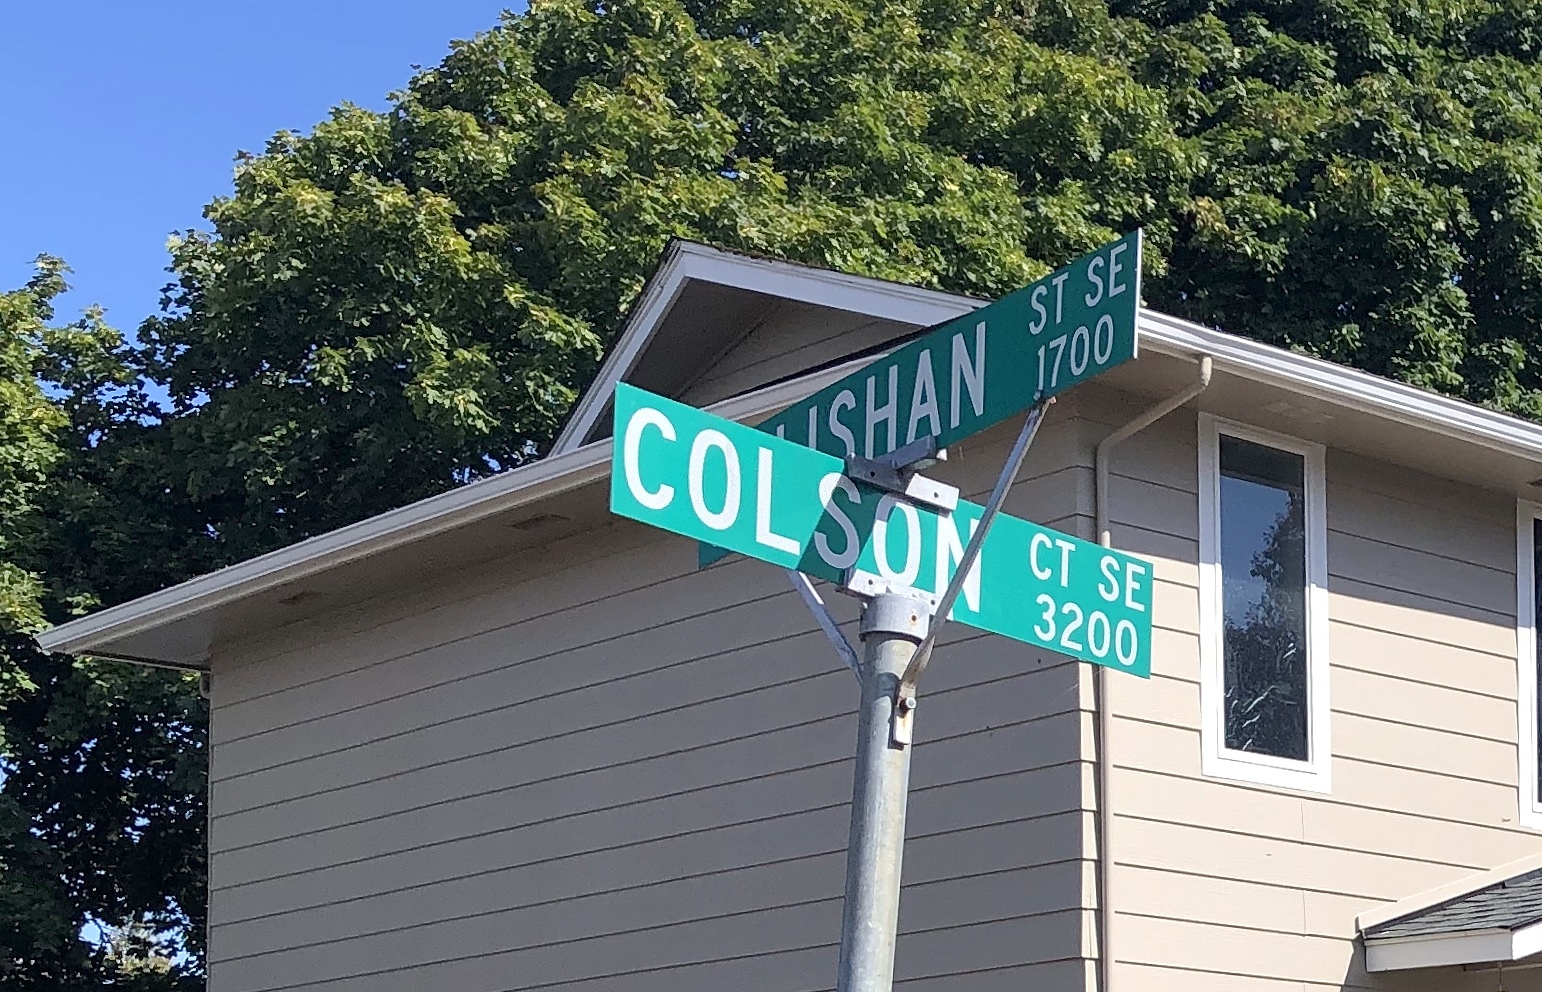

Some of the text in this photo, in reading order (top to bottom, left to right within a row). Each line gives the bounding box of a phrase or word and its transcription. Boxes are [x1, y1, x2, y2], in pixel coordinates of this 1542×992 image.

[1029, 241, 1128, 336] ST SE
[776, 320, 987, 460] ISHAN
[1036, 313, 1115, 396] 1700
[623, 406, 983, 614] COLSON
[1029, 531, 1147, 613] CT SE
[1033, 593, 1138, 667] 3200
